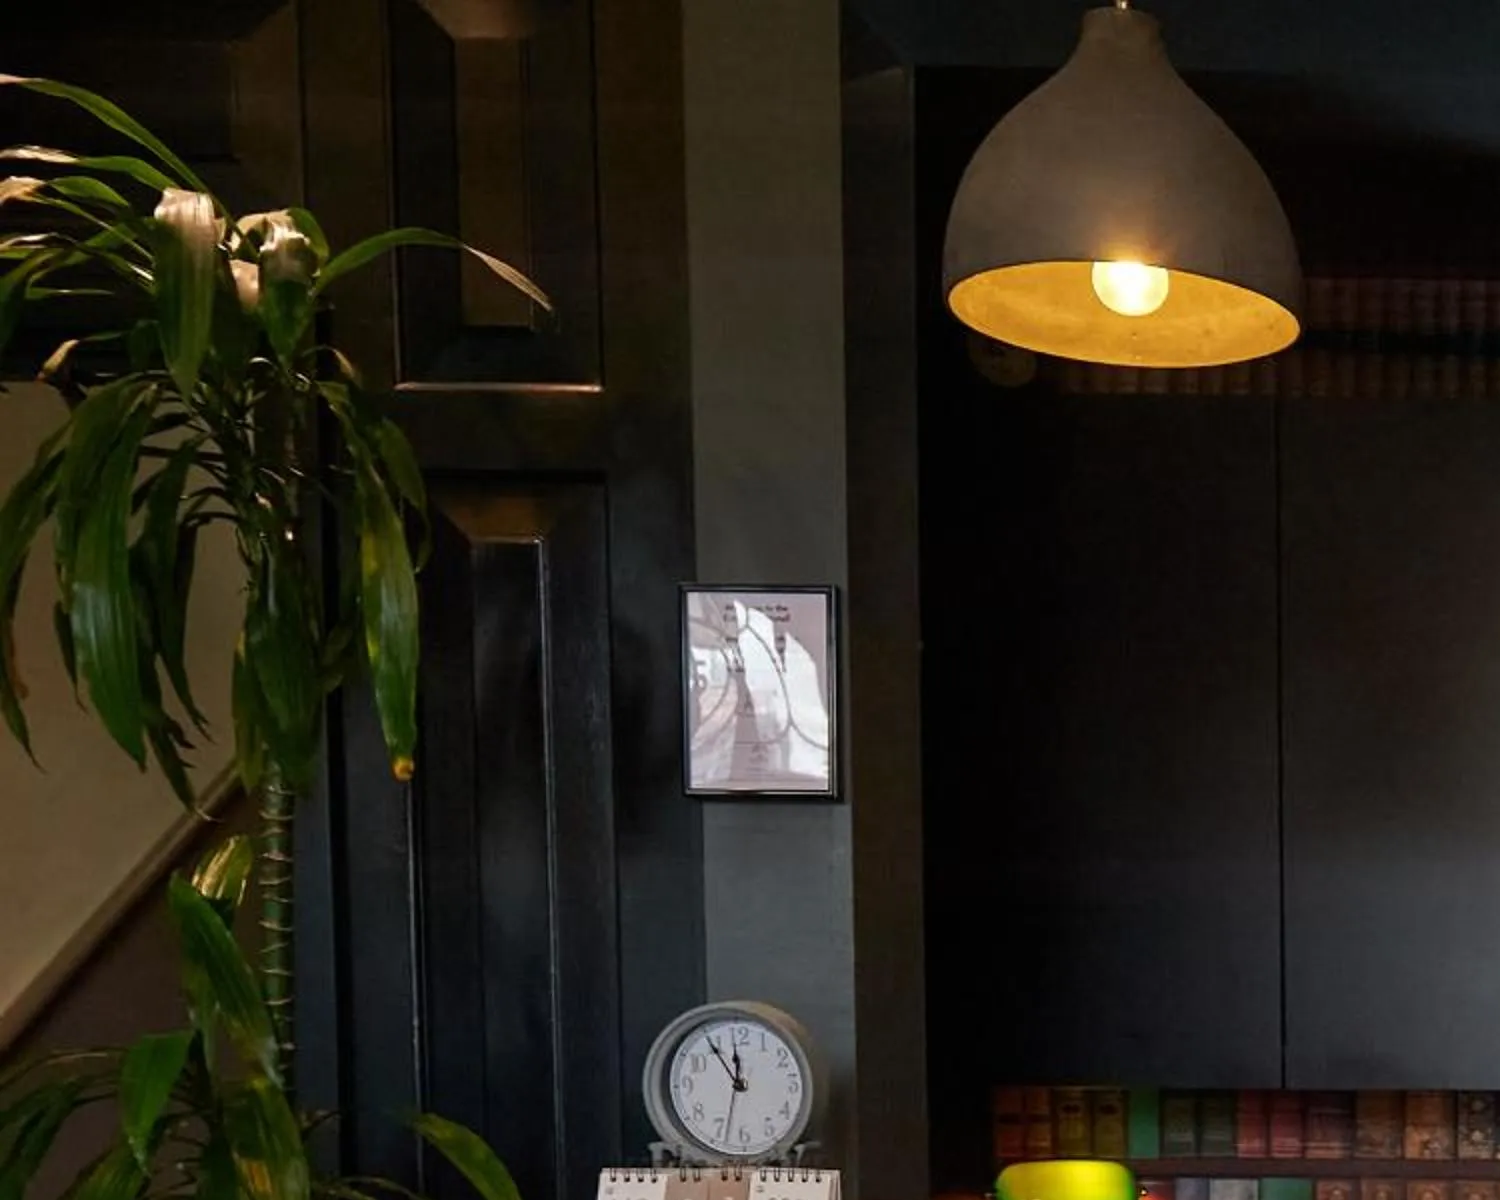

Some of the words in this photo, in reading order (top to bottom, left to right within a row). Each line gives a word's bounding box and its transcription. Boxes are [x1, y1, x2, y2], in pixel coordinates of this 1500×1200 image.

[729, 1026, 750, 1045] 12
[760, 1032, 767, 1051] 1
[690, 1054, 707, 1072] 10
[777, 1048, 788, 1067] 2
[682, 1076, 694, 1095] 9
[693, 1103, 704, 1120] 8
[779, 1101, 790, 1120] 4
[714, 1118, 725, 1137] 7
[739, 1127, 750, 1143] 6
[764, 1116, 774, 1137] 5
